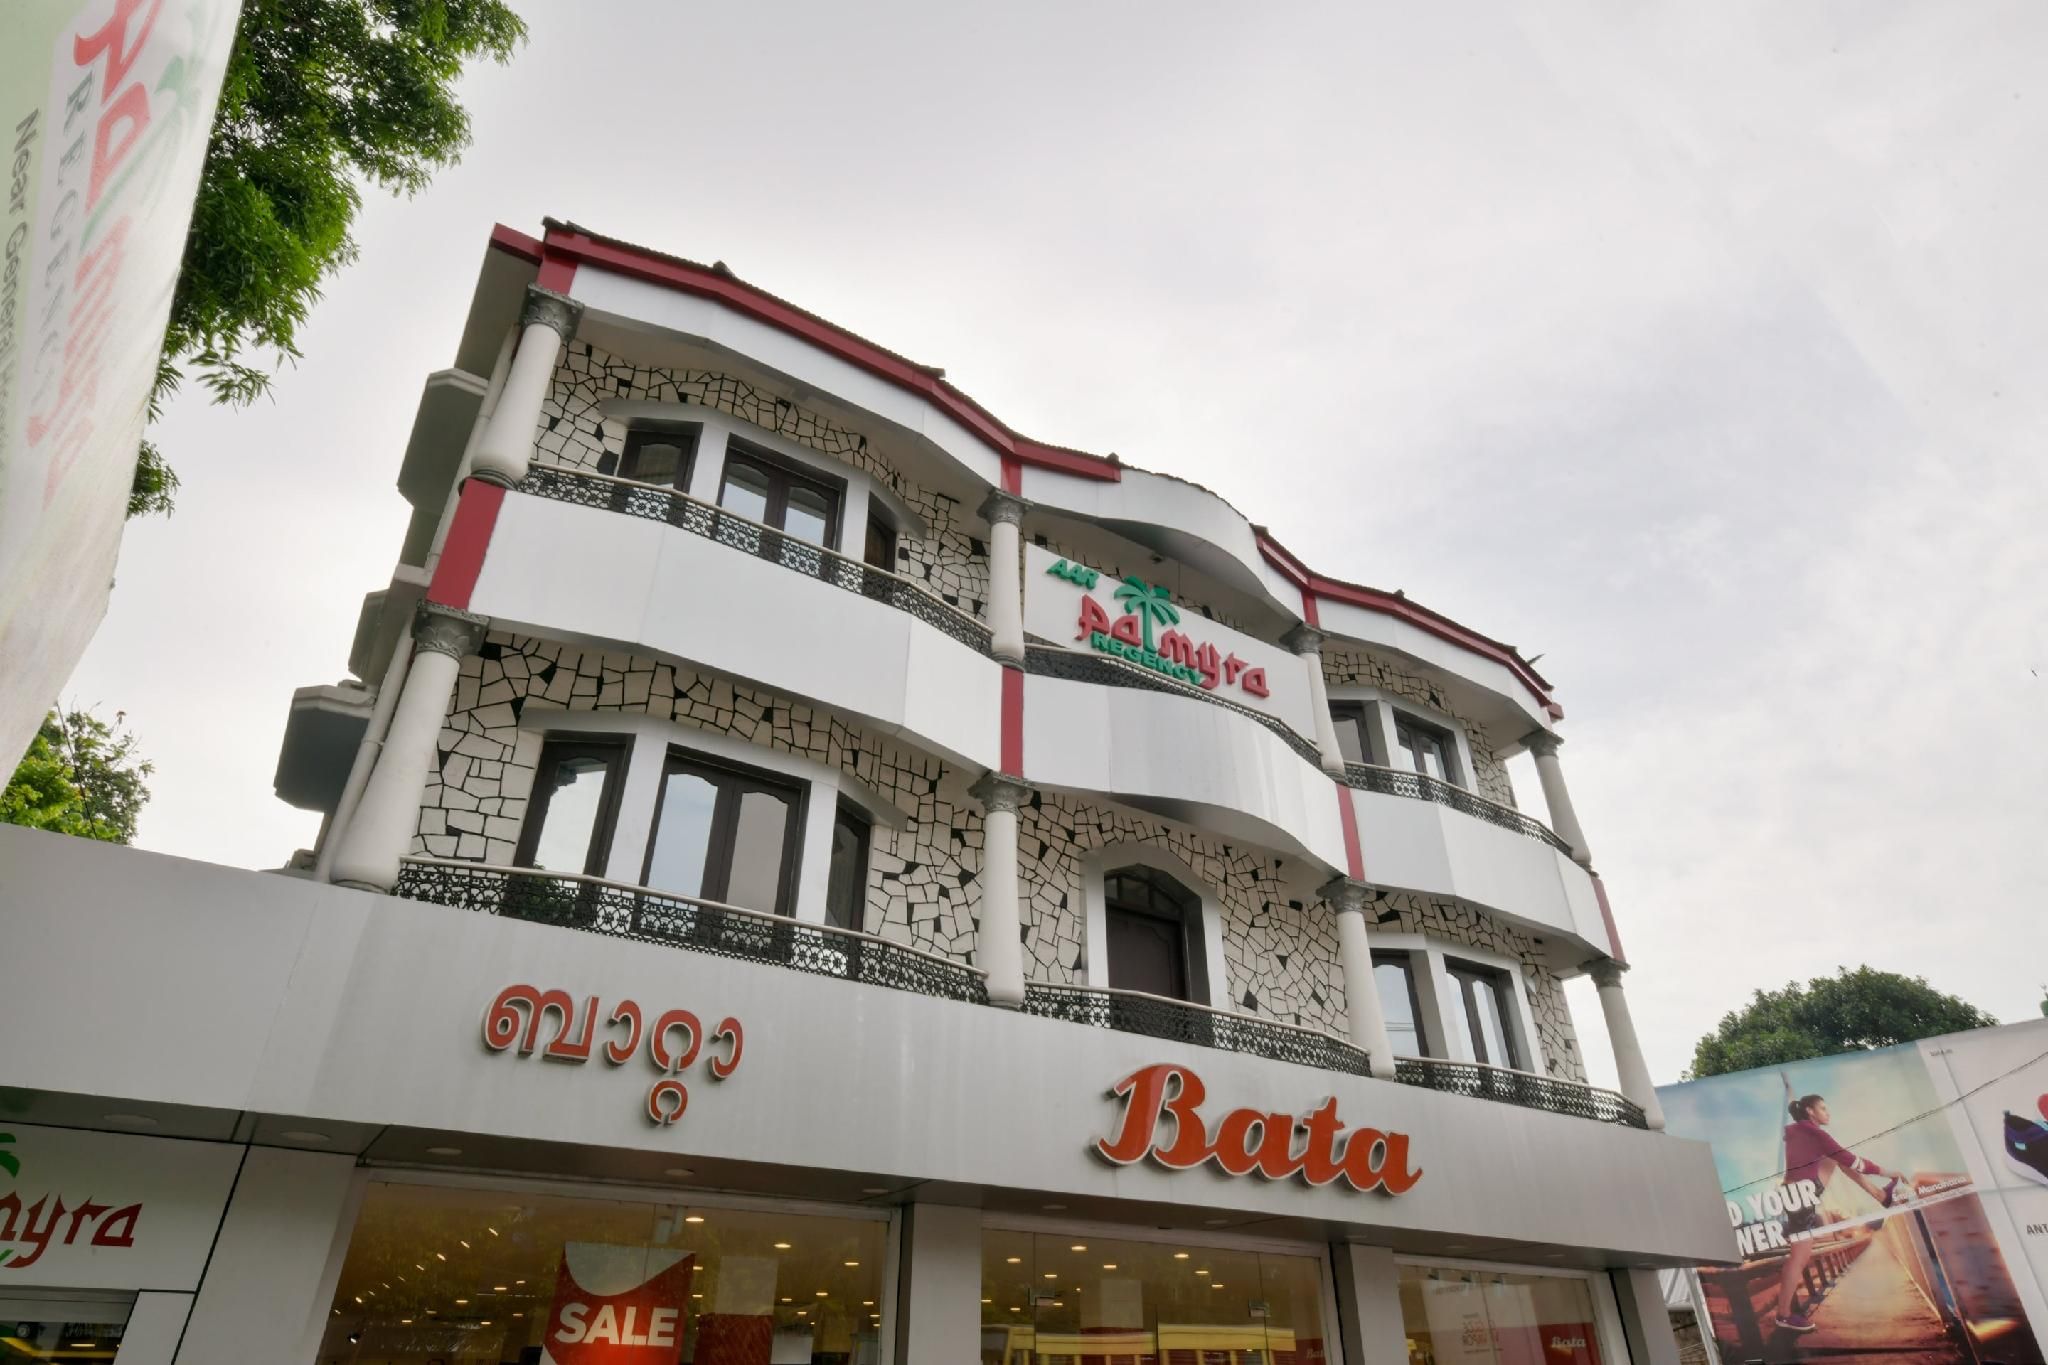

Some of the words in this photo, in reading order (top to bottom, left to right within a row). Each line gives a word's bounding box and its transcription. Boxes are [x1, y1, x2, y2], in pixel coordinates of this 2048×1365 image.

[8, 106, 40, 216] Near
[1046, 558, 1100, 590] AAR
[1090, 631, 1203, 686] REGENCY
[482, 983, 744, 1128] ബാറ്റാ
[1092, 1062, 1424, 1198] Bata
[1726, 1199, 1744, 1227] D
[1746, 1179, 1821, 1220] YOUR
[1735, 1220, 1788, 1257] NER
[2027, 1223, 2048, 1236] ANT
[554, 1301, 680, 1348] SALE
